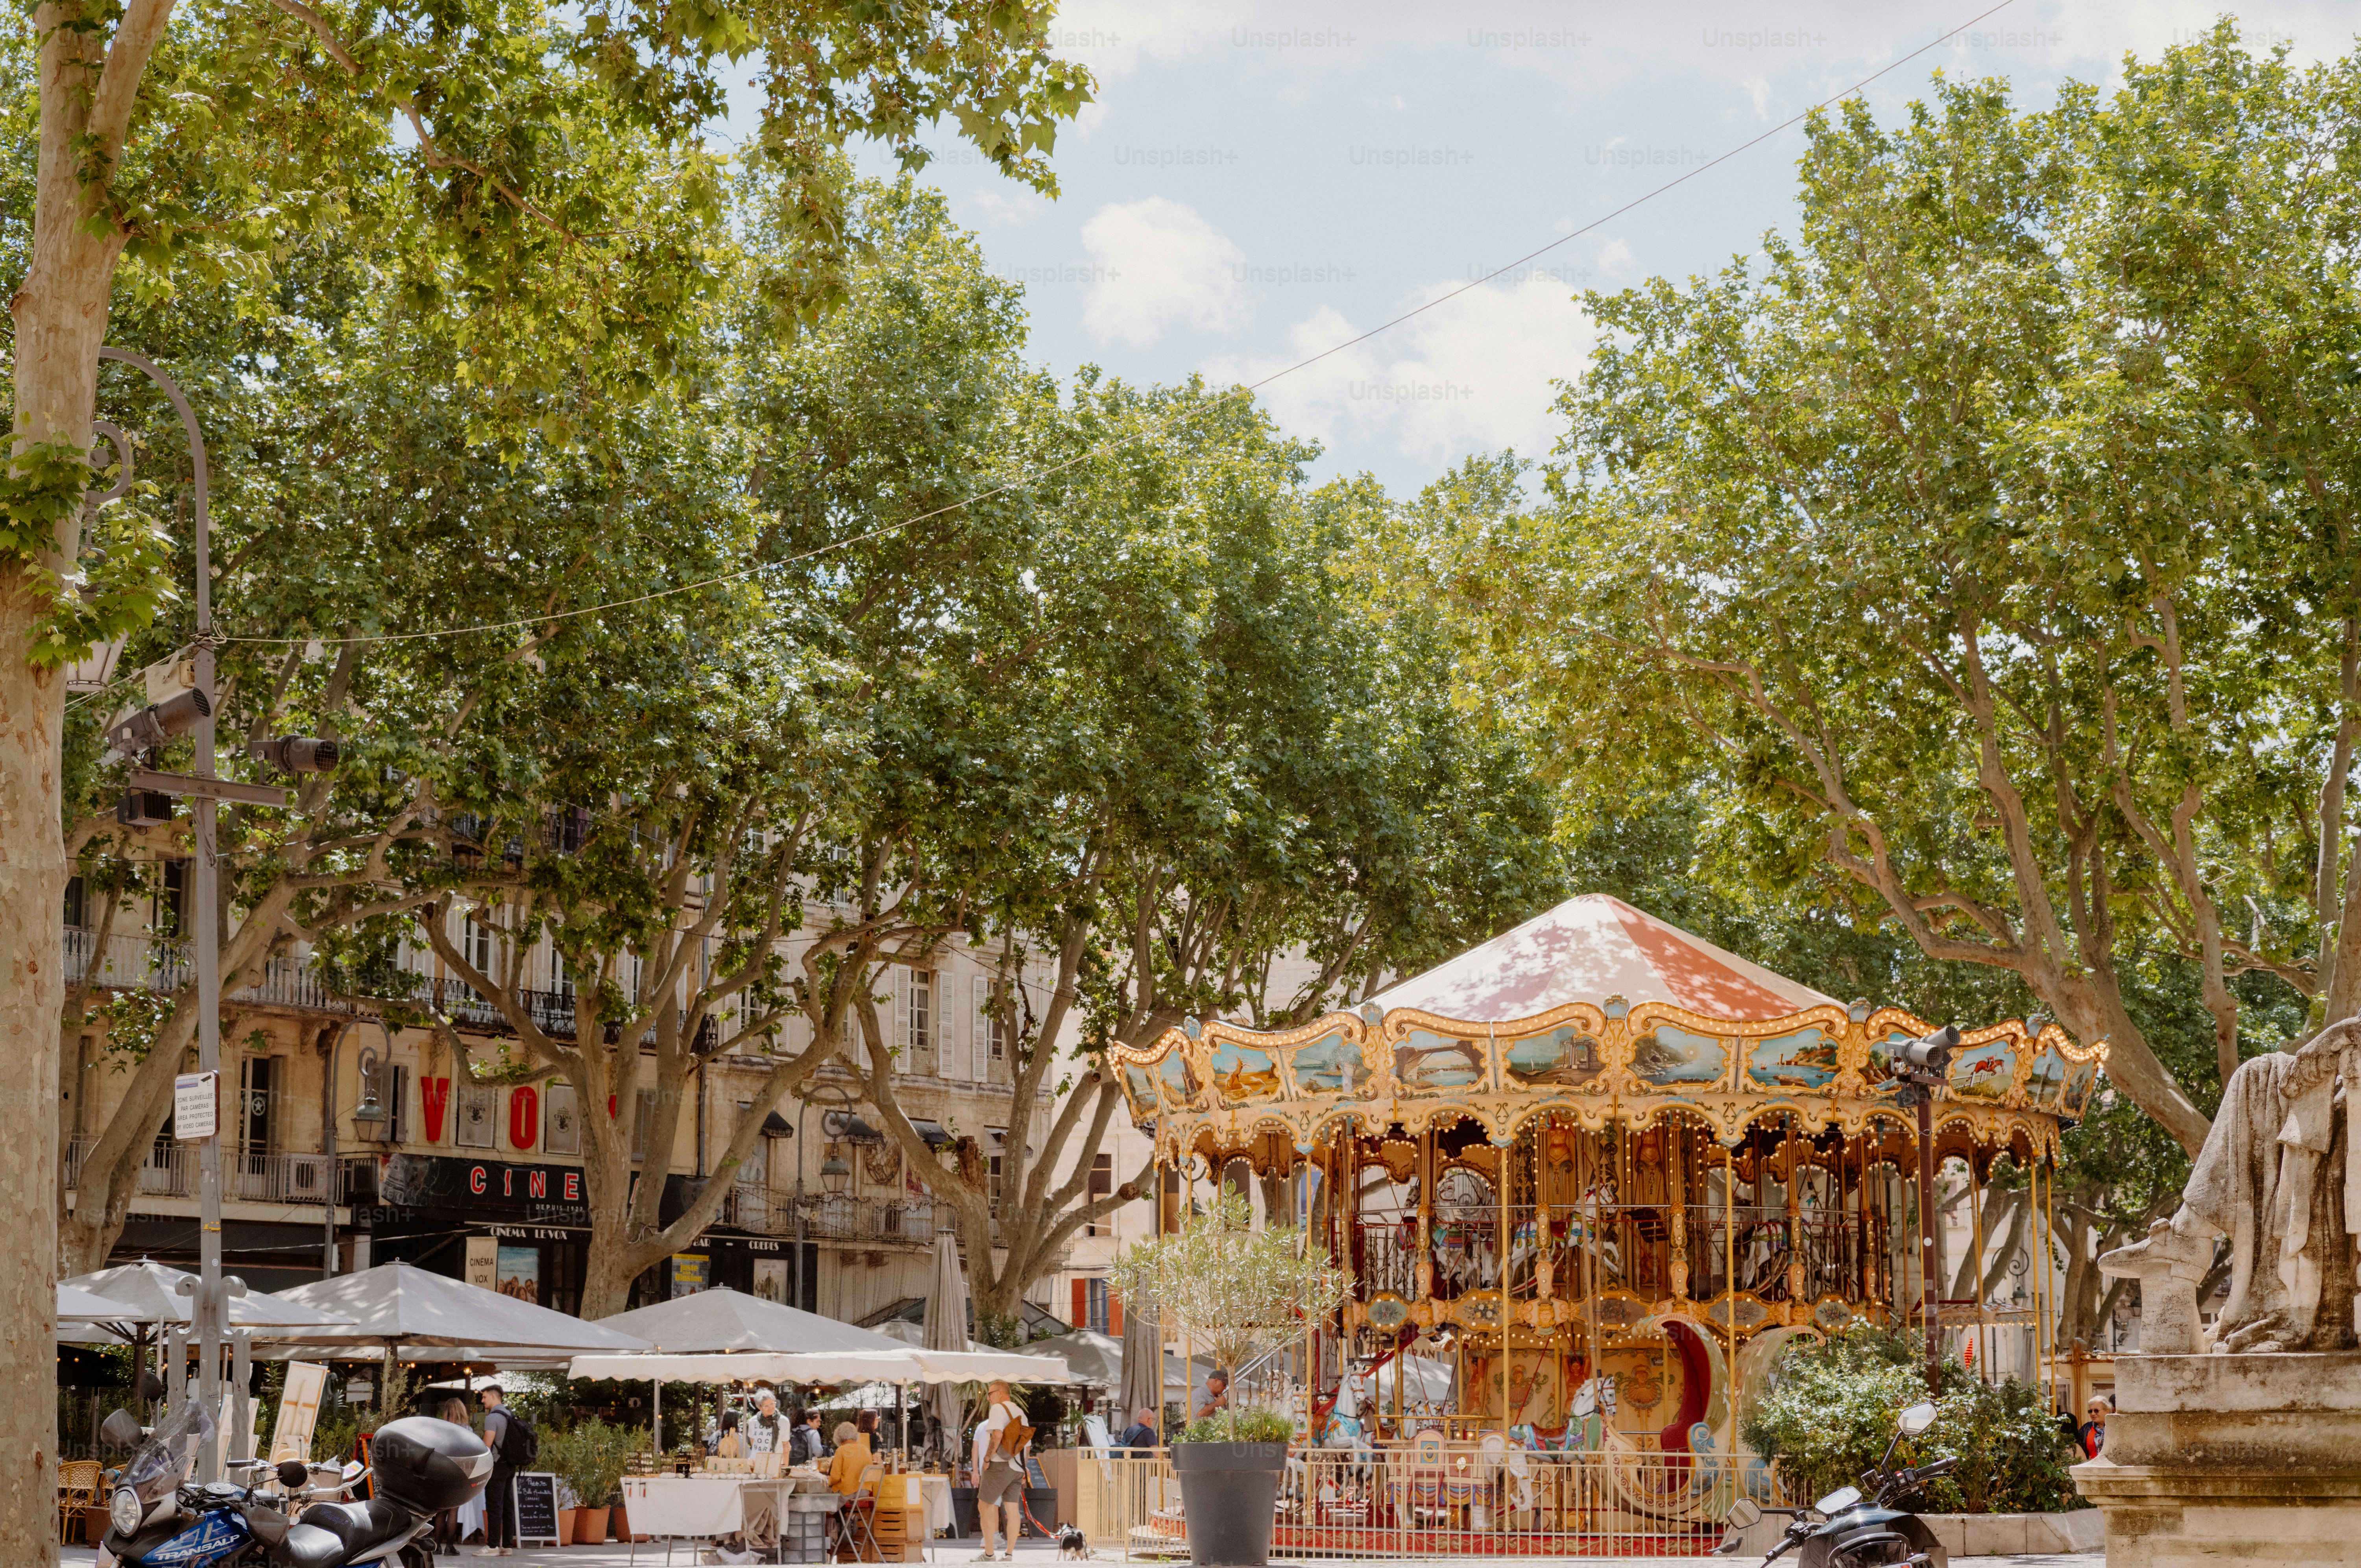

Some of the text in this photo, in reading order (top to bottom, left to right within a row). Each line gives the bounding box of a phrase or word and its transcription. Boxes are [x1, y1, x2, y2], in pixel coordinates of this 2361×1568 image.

[189, 1093, 213, 1101] SURVEILLÉE
[490, 1226, 526, 1238] CINEMA
[693, 1238, 711, 1247] BAR
[749, 1240, 779, 1251] CREPES
[470, 1256, 493, 1266] CINÉMA
[475, 1275, 488, 1283] VOX
[155, 1534, 240, 1561] TRANSALP
